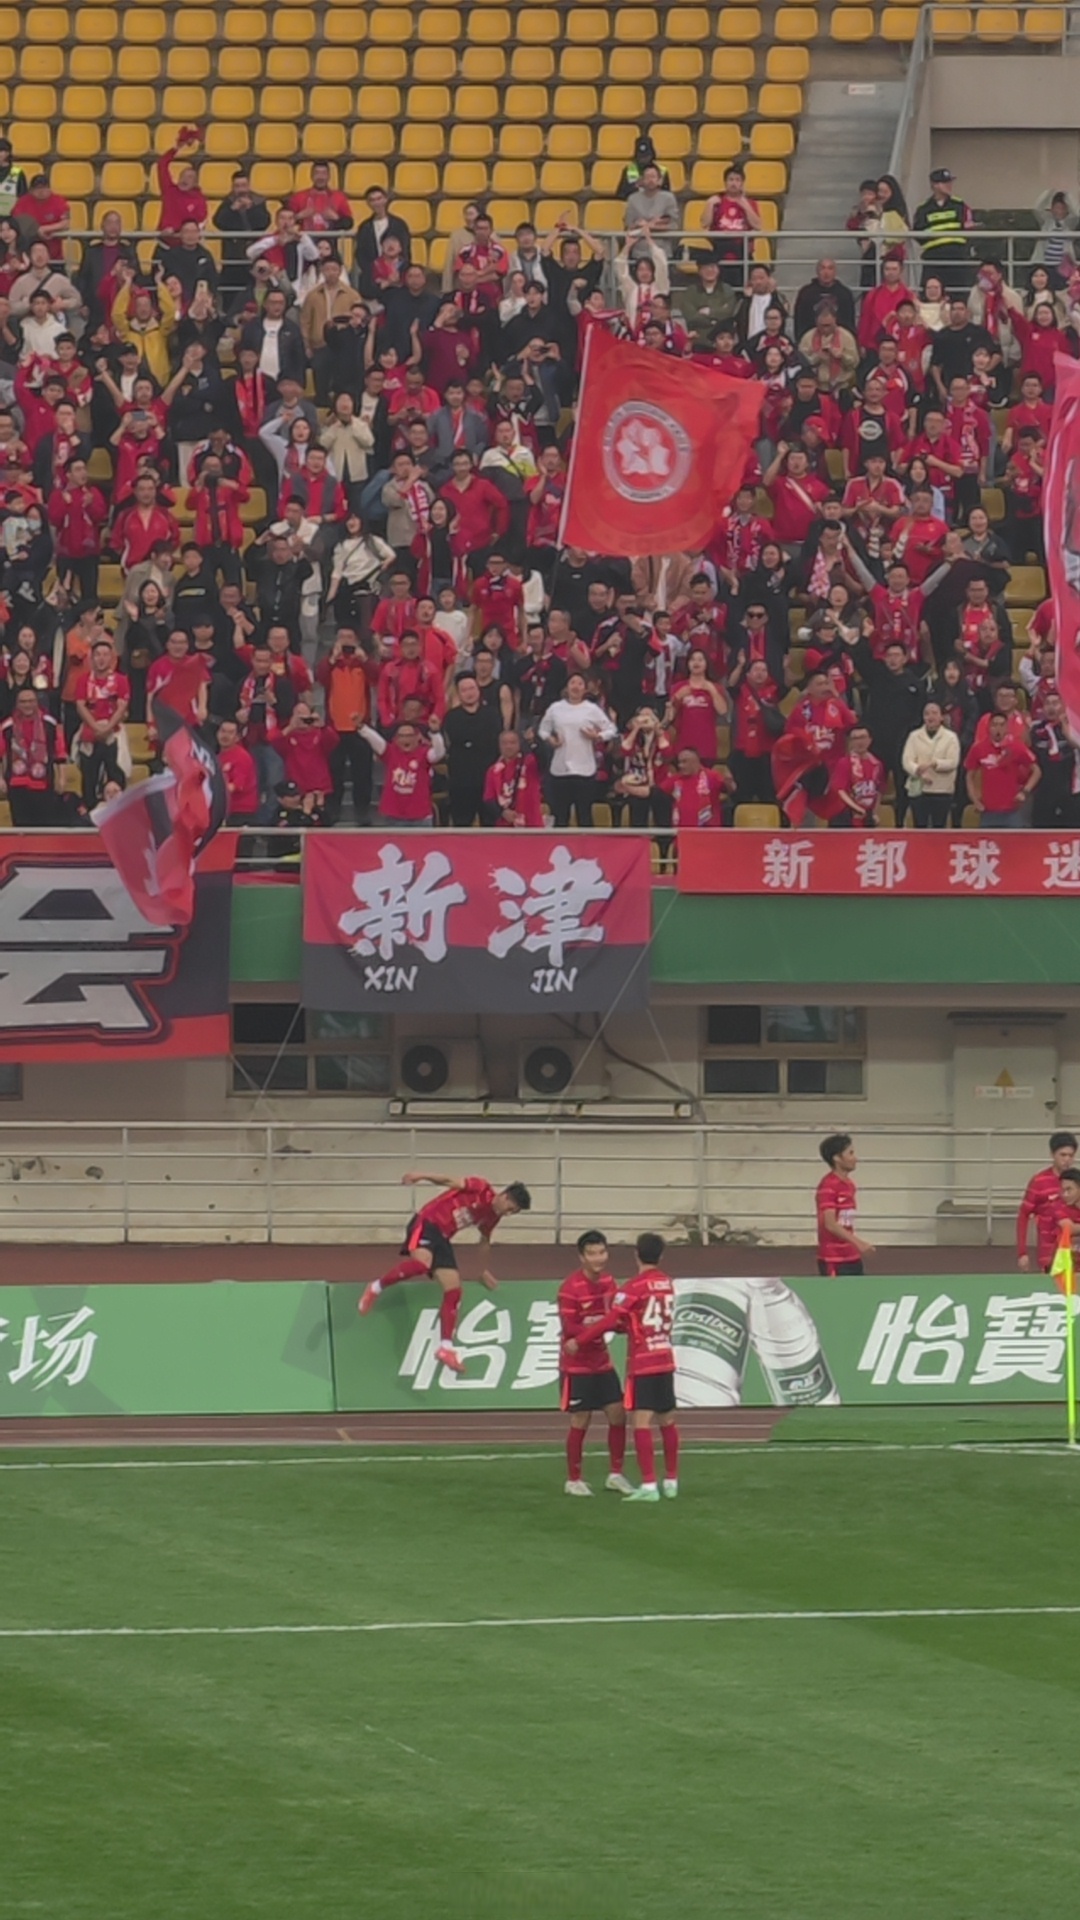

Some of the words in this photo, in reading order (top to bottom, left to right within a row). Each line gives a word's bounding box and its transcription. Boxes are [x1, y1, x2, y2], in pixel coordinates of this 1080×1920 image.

[762, 838, 1080, 890] 新都球迷
[338, 843, 614, 968] 新津
[363, 964, 419, 993] XIN
[529, 966, 579, 994] JIN
[0, 1306, 99, 1391] 场
